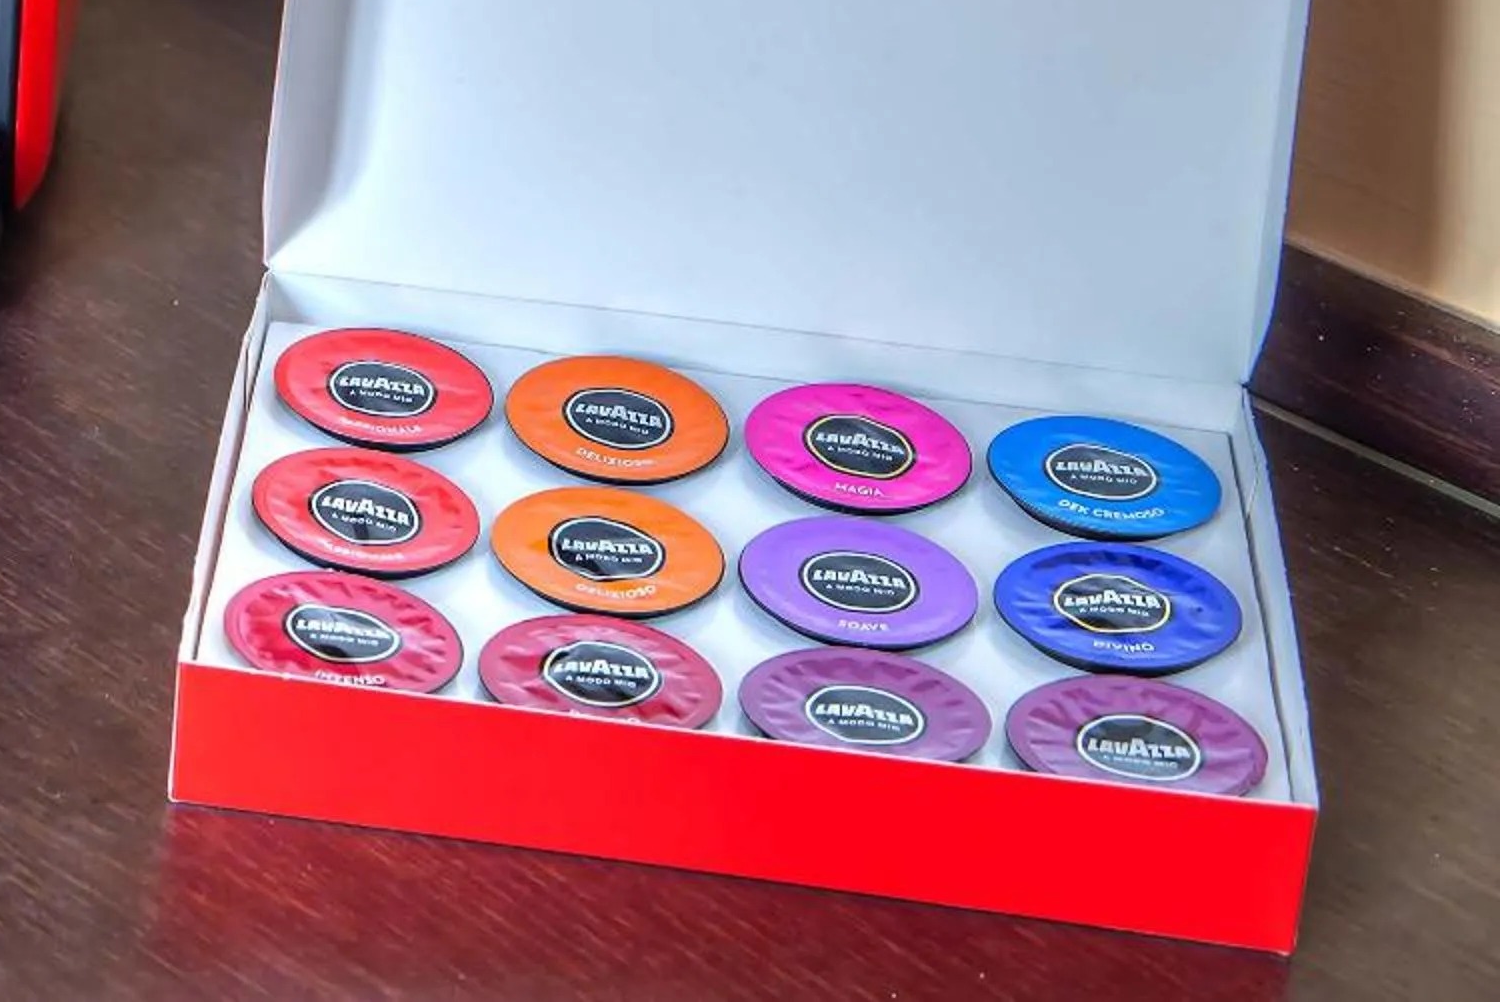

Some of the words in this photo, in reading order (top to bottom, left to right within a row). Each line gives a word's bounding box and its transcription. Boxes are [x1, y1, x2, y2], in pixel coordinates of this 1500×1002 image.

[340, 377, 425, 396] LAVAZZA
[575, 403, 662, 428] LAVAZZA
[815, 432, 905, 455] LAVAZZA
[1055, 459, 1149, 477] LAVAZZA
[835, 482, 884, 497] MAGIA
[321, 496, 410, 527] LAVAZZA
[1058, 499, 1090, 515] DEK
[1093, 508, 1165, 519] CREMOSO
[561, 538, 654, 555] LAVAZZA
[812, 569, 906, 589] LAVAZZA
[1064, 589, 1161, 608] LAVAZZA
[295, 618, 394, 639] LAVAZZA
[838, 619, 889, 631] SOAVE
[1093, 639, 1156, 653] DIVINO
[553, 659, 651, 679] LAVAZZA
[815, 703, 915, 726] LAVAZZA
[1088, 737, 1191, 759] LAVAZZA
